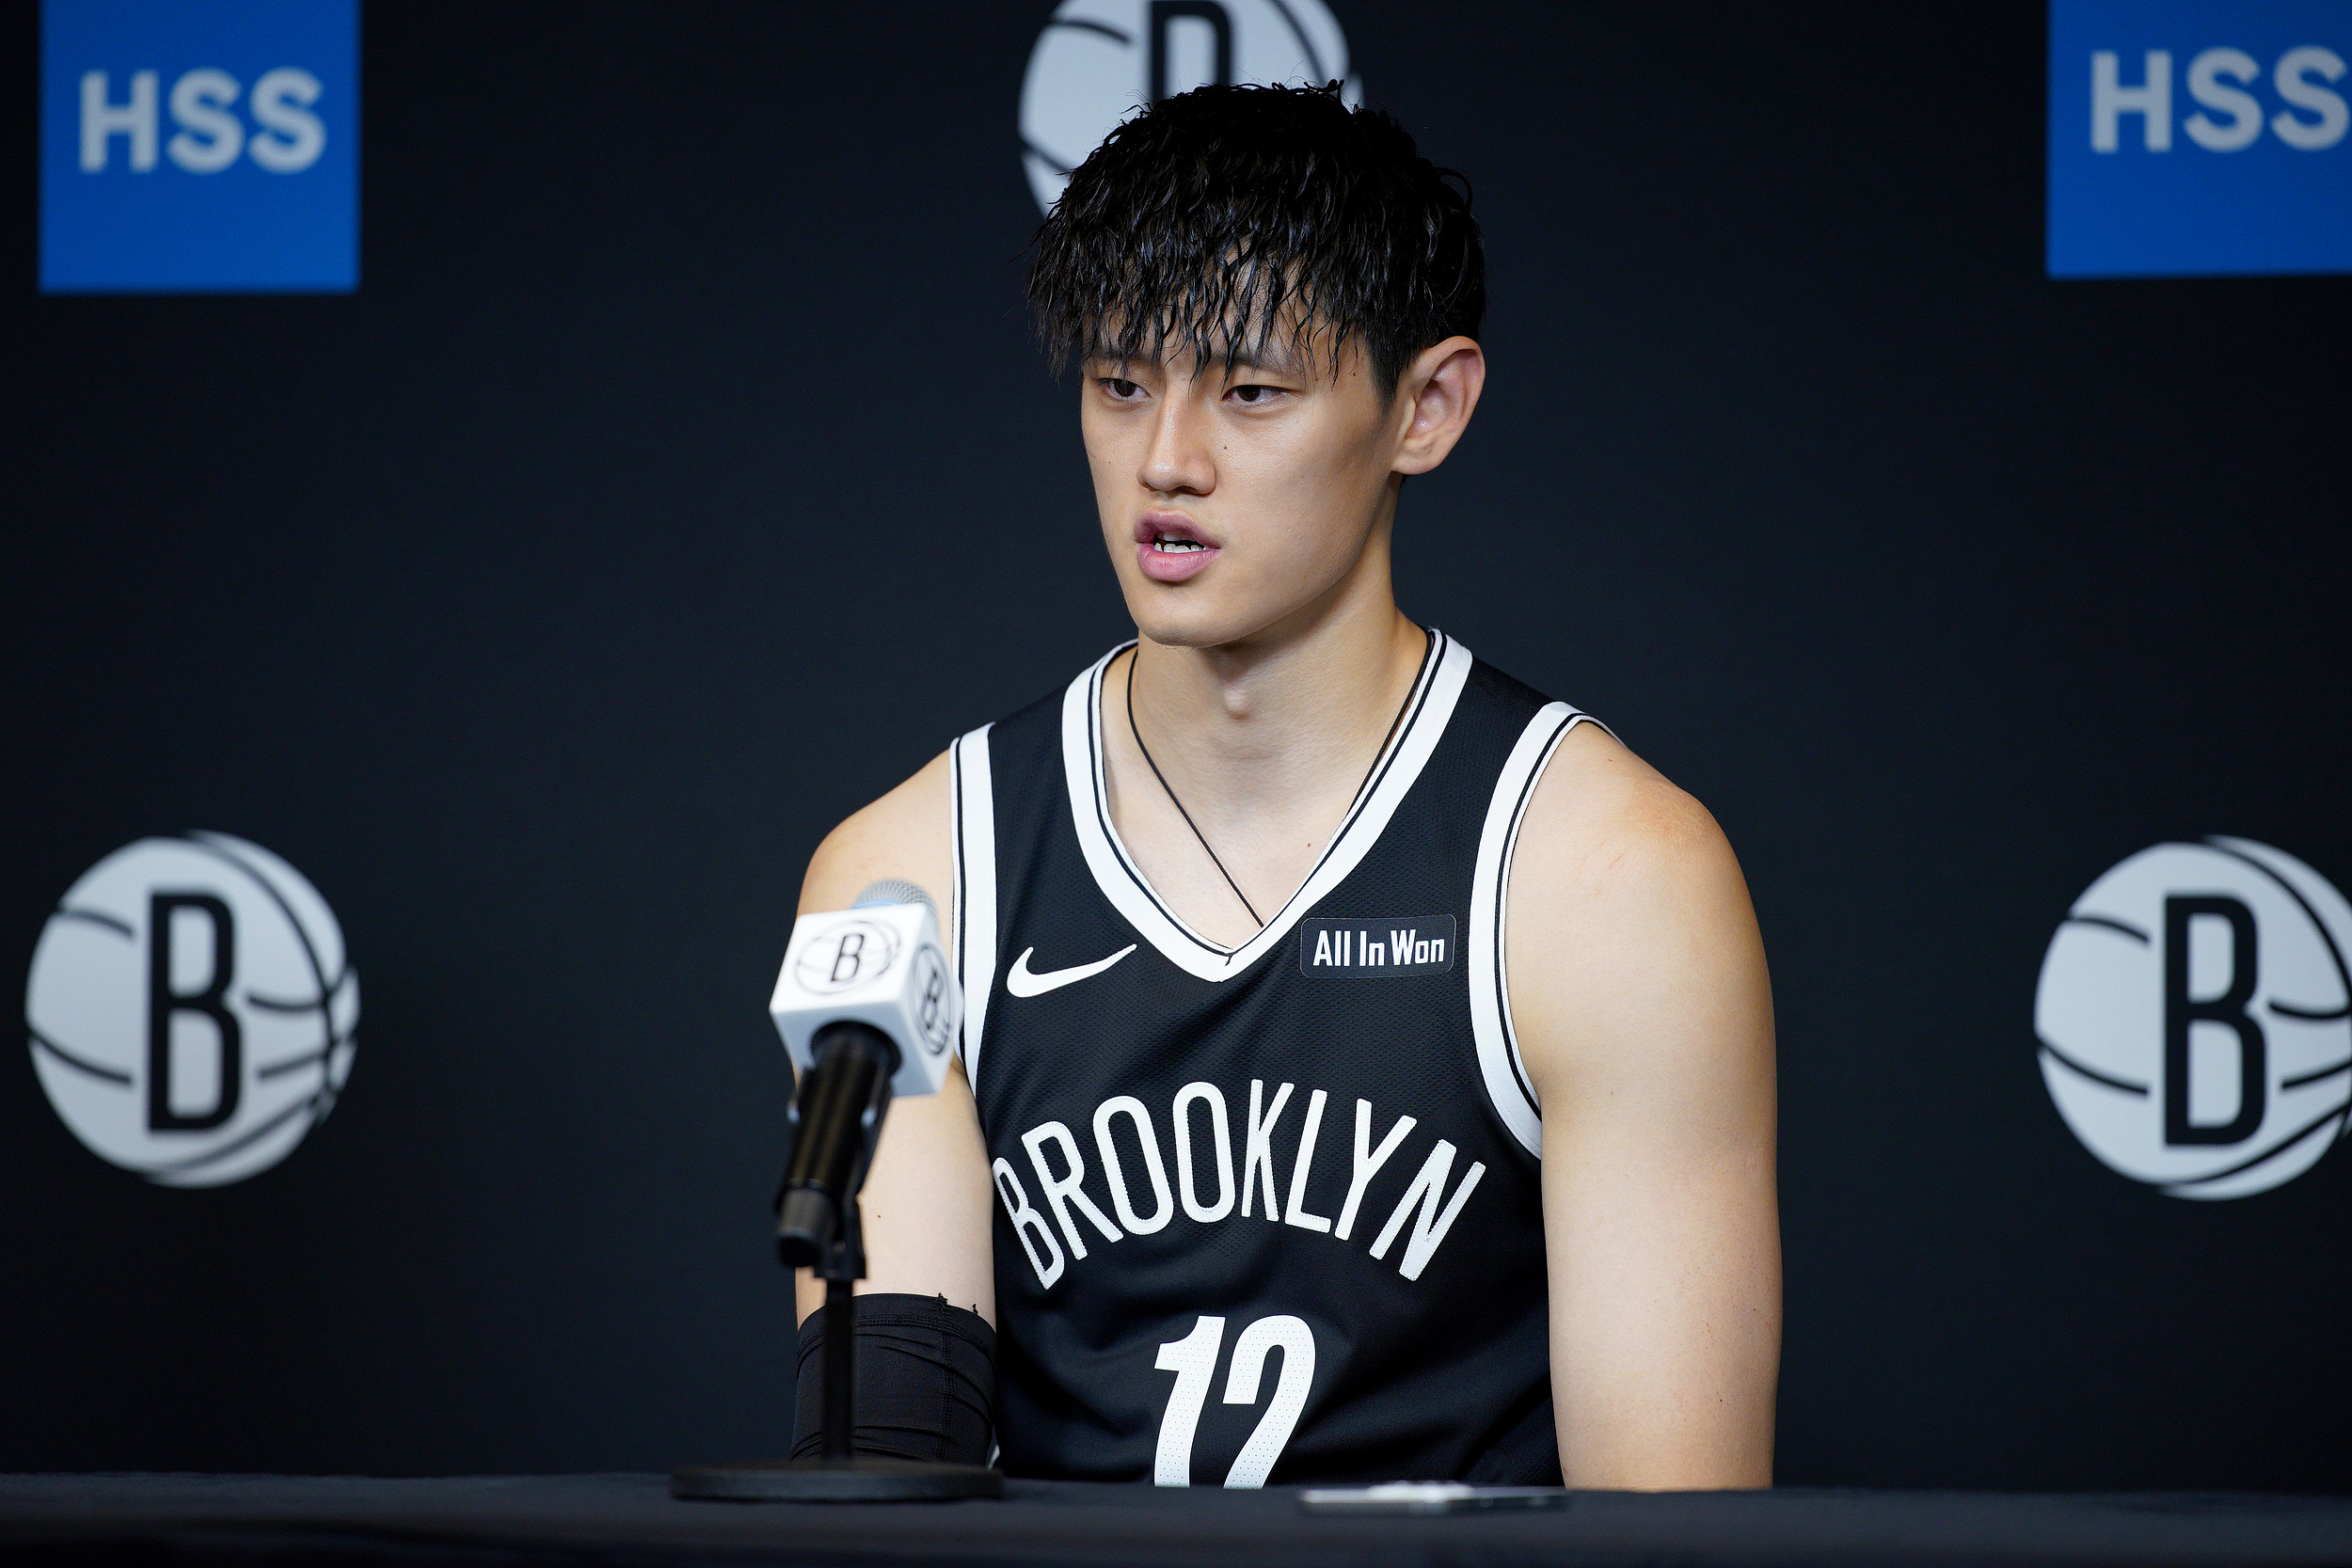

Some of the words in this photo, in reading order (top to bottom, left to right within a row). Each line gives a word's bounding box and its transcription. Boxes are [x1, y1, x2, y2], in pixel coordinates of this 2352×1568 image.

[79, 68, 327, 175] HSS
[2090, 45, 2352, 154] HSS
[149, 893, 243, 1132] B
[830, 933, 865, 983] B
[1312, 929, 1351, 967] All
[1359, 930, 1386, 967] In
[1391, 928, 1445, 966] Won
[2164, 895, 2267, 1147] B
[992, 1079, 1486, 1290] BROOKLYN
[1153, 1314, 1316, 1489] 12
